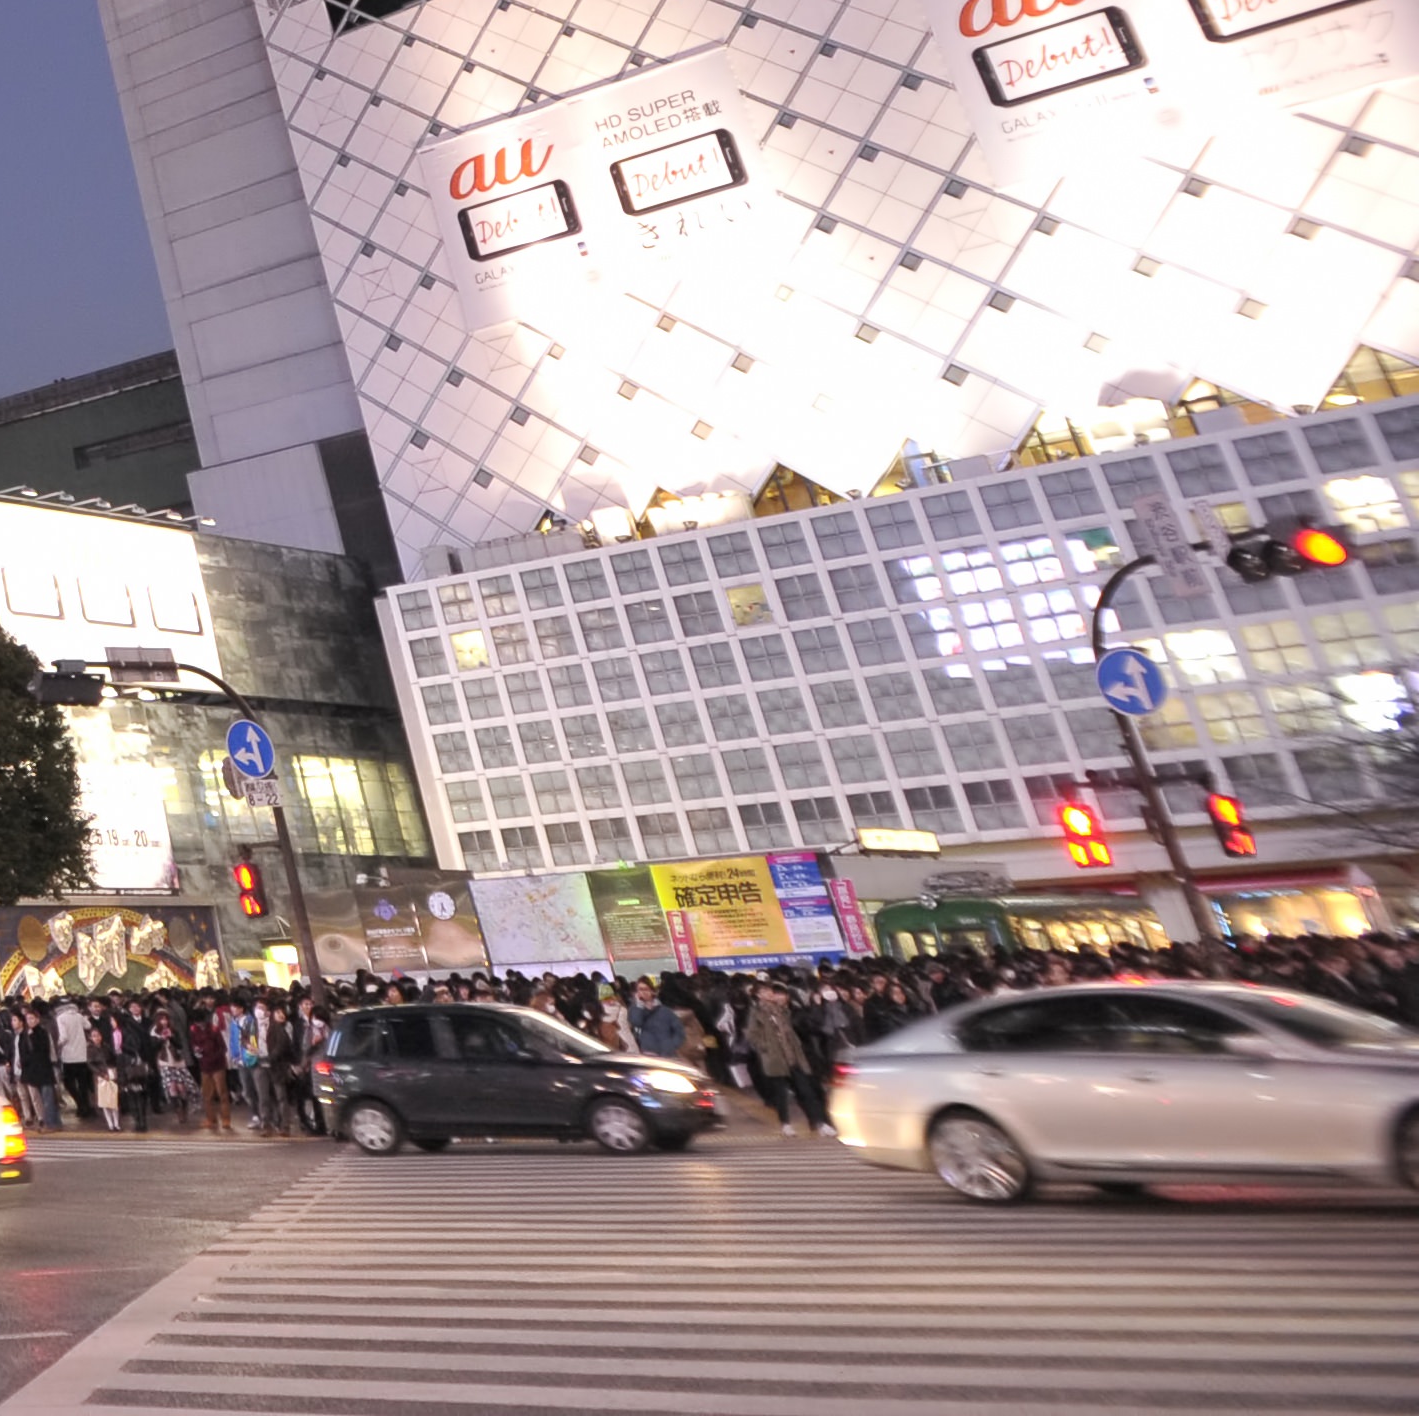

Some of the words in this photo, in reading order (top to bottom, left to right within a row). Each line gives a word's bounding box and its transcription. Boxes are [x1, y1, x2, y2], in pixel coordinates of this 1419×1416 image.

[997, 26, 1114, 88] Debut!
[594, 114, 622, 133] HD
[627, 89, 697, 122] SUPER
[602, 99, 723, 149] AMOLED搭載
[449, 137, 555, 201] au
[631, 147, 720, 198] Debut!
[673, 881, 763, 909] 確定申告
